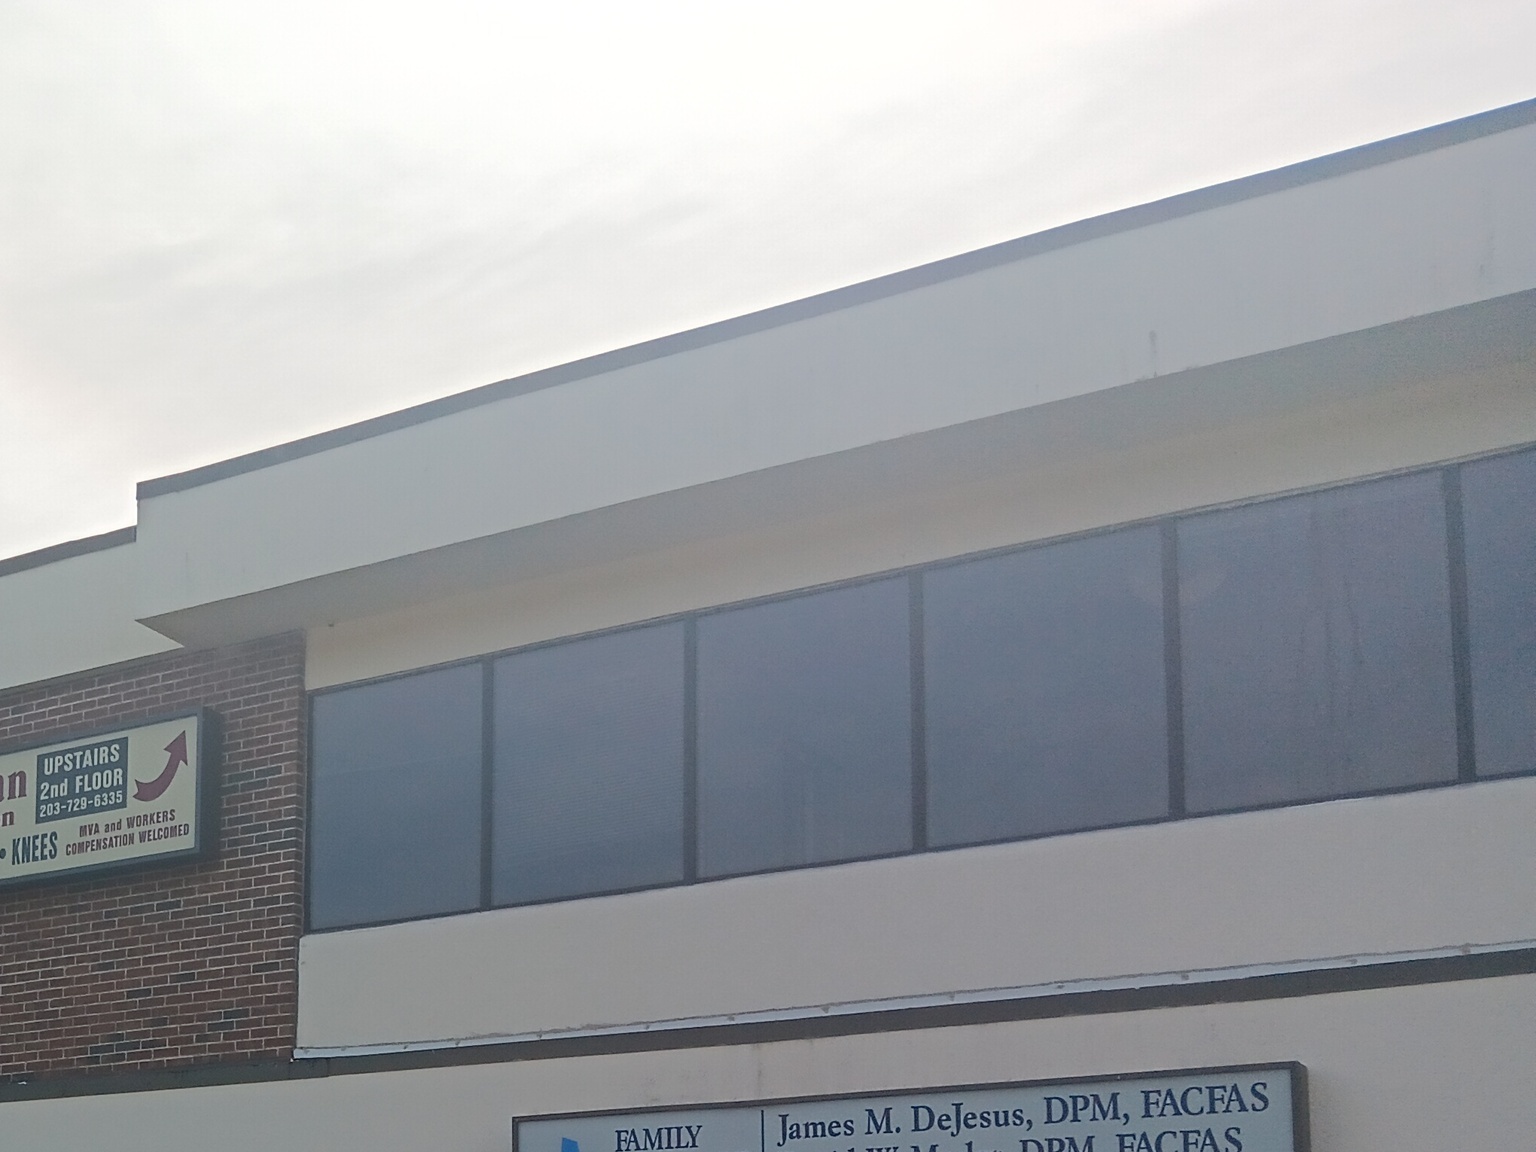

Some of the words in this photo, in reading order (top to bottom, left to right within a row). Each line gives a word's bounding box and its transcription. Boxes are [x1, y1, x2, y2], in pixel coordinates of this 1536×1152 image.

[43, 744, 120, 776] UPSTAIRS
[40, 781, 68, 801] 2nd
[75, 769, 123, 794] FLOOR
[39, 790, 123, 818] 203-729-6335
[79, 823, 100, 837] MVA
[104, 818, 122, 833] and
[126, 809, 176, 830] WORKERS
[12, 831, 58, 865] KNEES
[65, 832, 135, 857] COMPENSATION
[139, 823, 190, 845] WELCOMED
[777, 1114, 855, 1147] James
[865, 1107, 901, 1135] M.
[911, 1102, 1033, 1137] DeJesus,
[1044, 1092, 1130, 1126] DPM,
[1141, 1082, 1270, 1118] FACFAS
[615, 1125, 702, 1152] FAMILY
